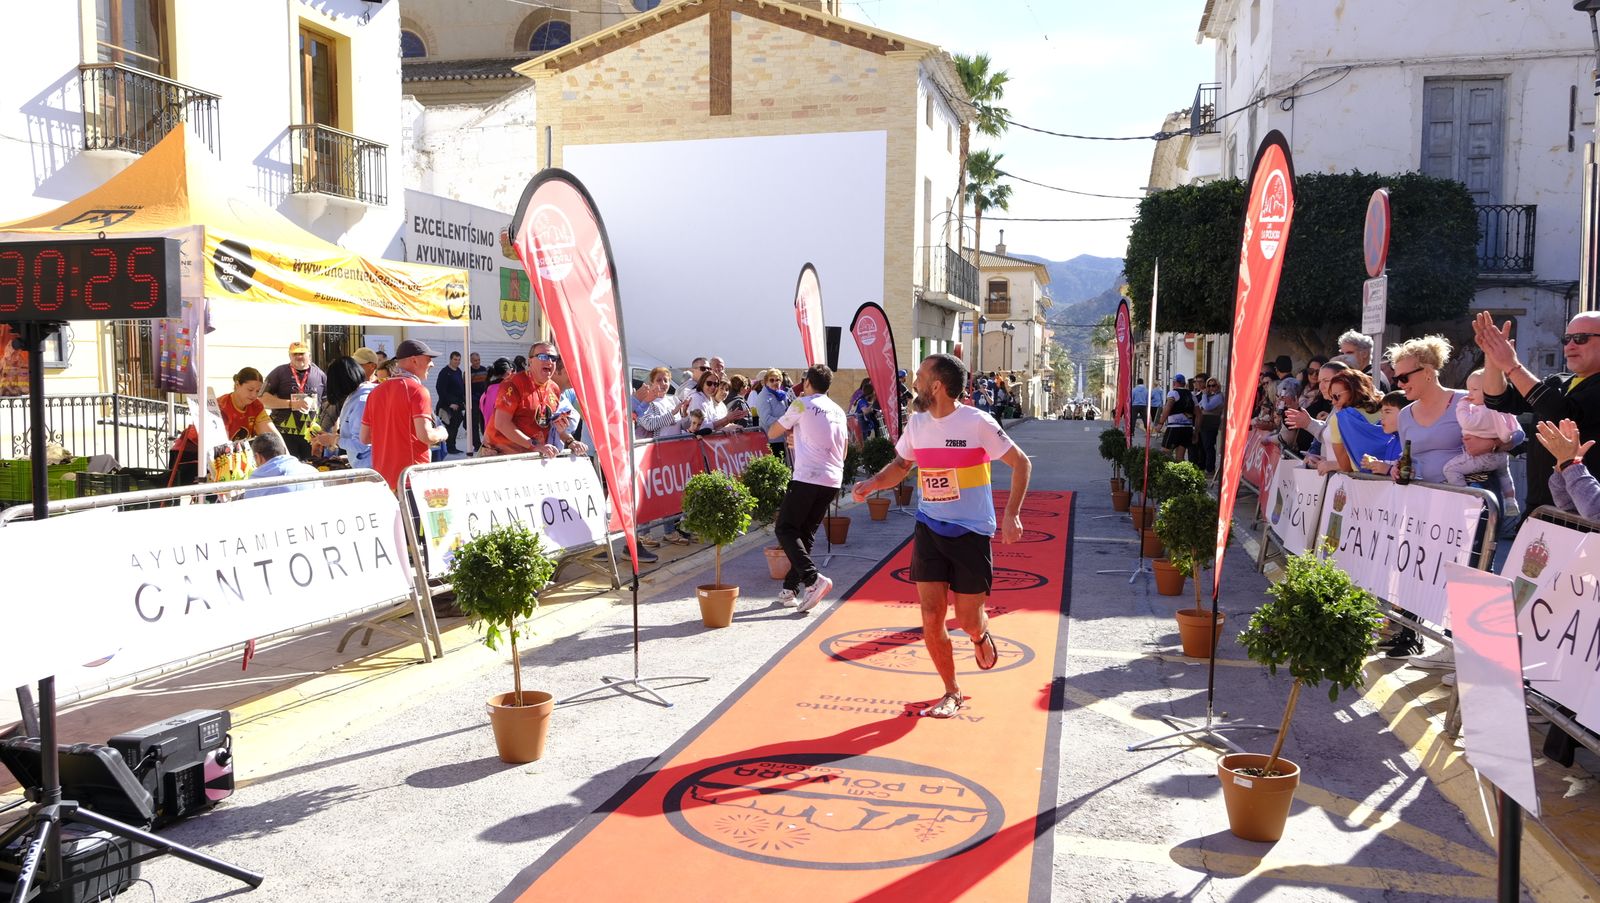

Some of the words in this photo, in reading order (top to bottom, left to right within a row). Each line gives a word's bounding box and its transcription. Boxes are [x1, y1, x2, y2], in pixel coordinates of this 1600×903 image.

[414, 215, 494, 247] EXCELENTÍSIMO
[416, 244, 493, 272] AYUNTAMIENTO
[926, 477, 949, 488] 122
[468, 494, 598, 541] CANTORIA
[130, 518, 347, 571] AYUNTAMIENTO
[356, 512, 380, 531] DE
[1447, 527, 1462, 547] DE
[1340, 526, 1457, 589] CANTORI
[134, 536, 393, 623] CANTORIA
[734, 766, 906, 792] POLVORA
[919, 783, 966, 797] LA
